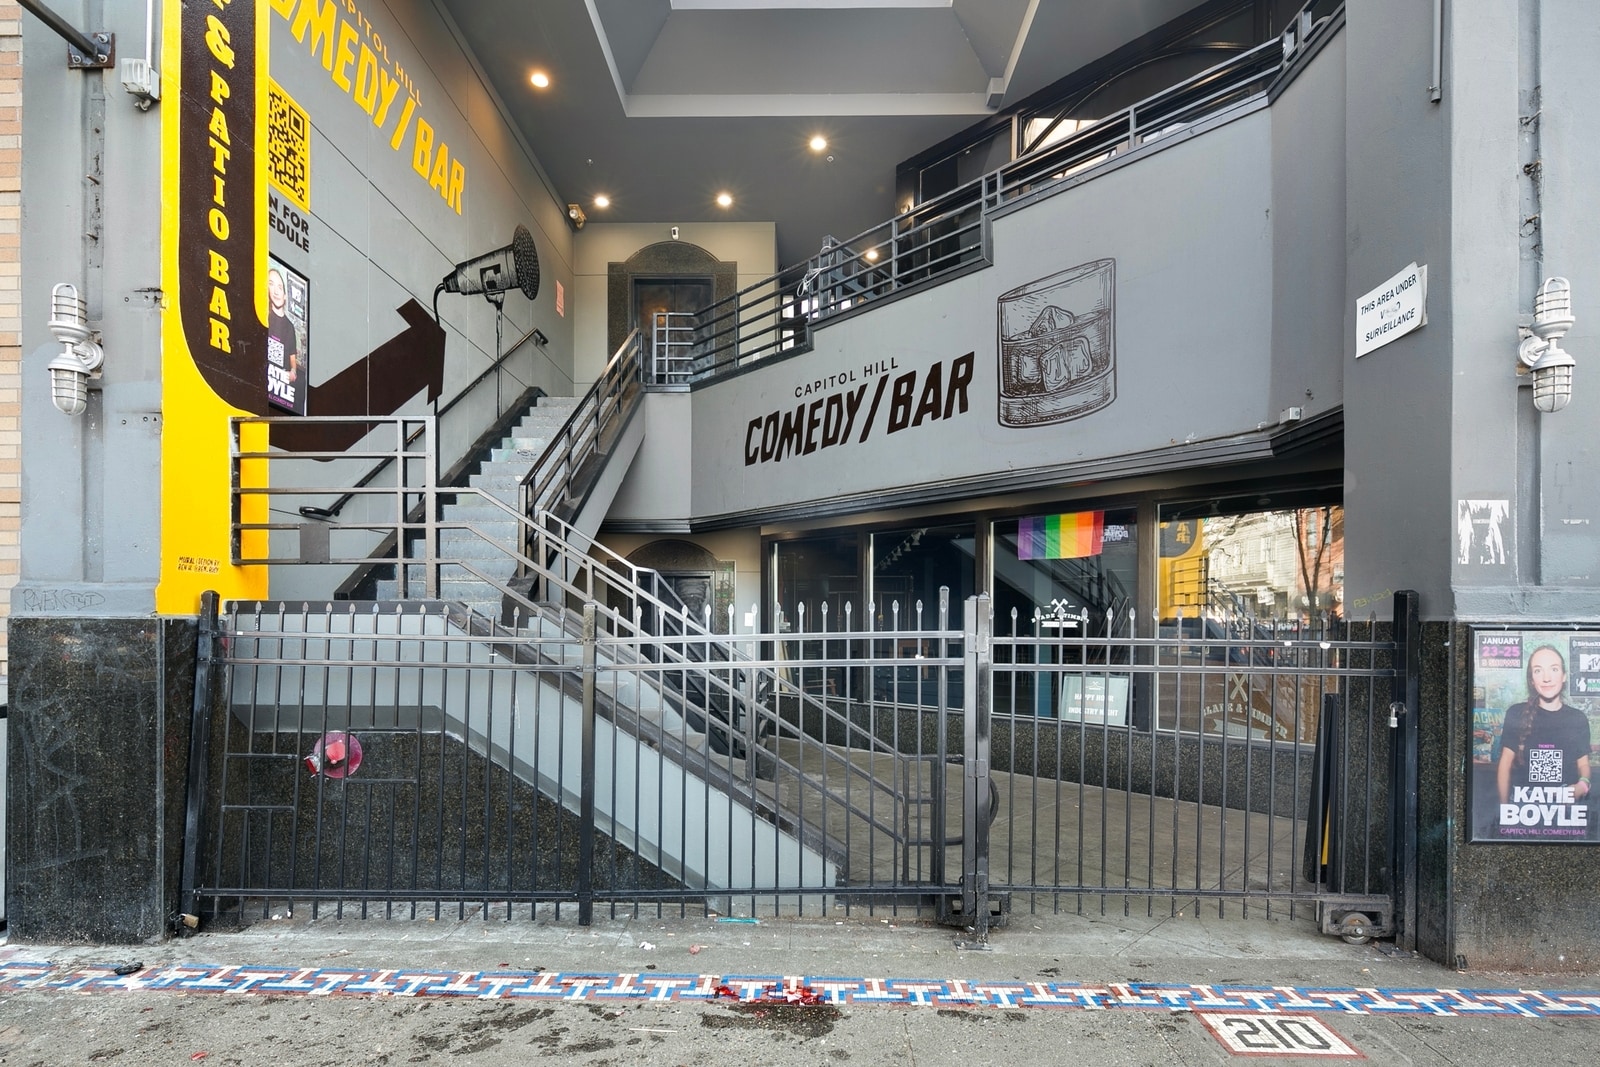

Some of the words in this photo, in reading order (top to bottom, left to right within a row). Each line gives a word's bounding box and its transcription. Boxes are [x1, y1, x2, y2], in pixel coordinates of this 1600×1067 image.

[205, 14, 235, 70] &
[395, 61, 422, 107] HILL
[208, 69, 231, 241] PATIO
[268, 210, 310, 254] EDULE
[283, 204, 309, 237] FOR
[208, 249, 232, 354] BAR
[1361, 300, 1376, 316] THIS
[1377, 289, 1395, 308] AREA
[1396, 274, 1417, 295] UNDER
[1365, 307, 1415, 342] SURVEILLANCE
[267, 363, 290, 385] ATIE
[795, 370, 857, 398] CAPITOL
[864, 357, 899, 378] HILL
[1031, 613, 1056, 623] BADE
[1482, 637, 1520, 645] JANUARY
[1482, 646, 1520, 657] 23-25
[1068, 706, 1098, 715] INDUTRY
[1099, 709, 1119, 717] NGHT
[1074, 693, 1095, 701] HAPY
[1096, 694, 1114, 702] HOR
[1513, 786, 1575, 804] KATIE
[1499, 804, 1588, 826] BOYLE
[1500, 828, 1527, 836] CAPITOL
[1222, 1018, 1332, 1050] 210
